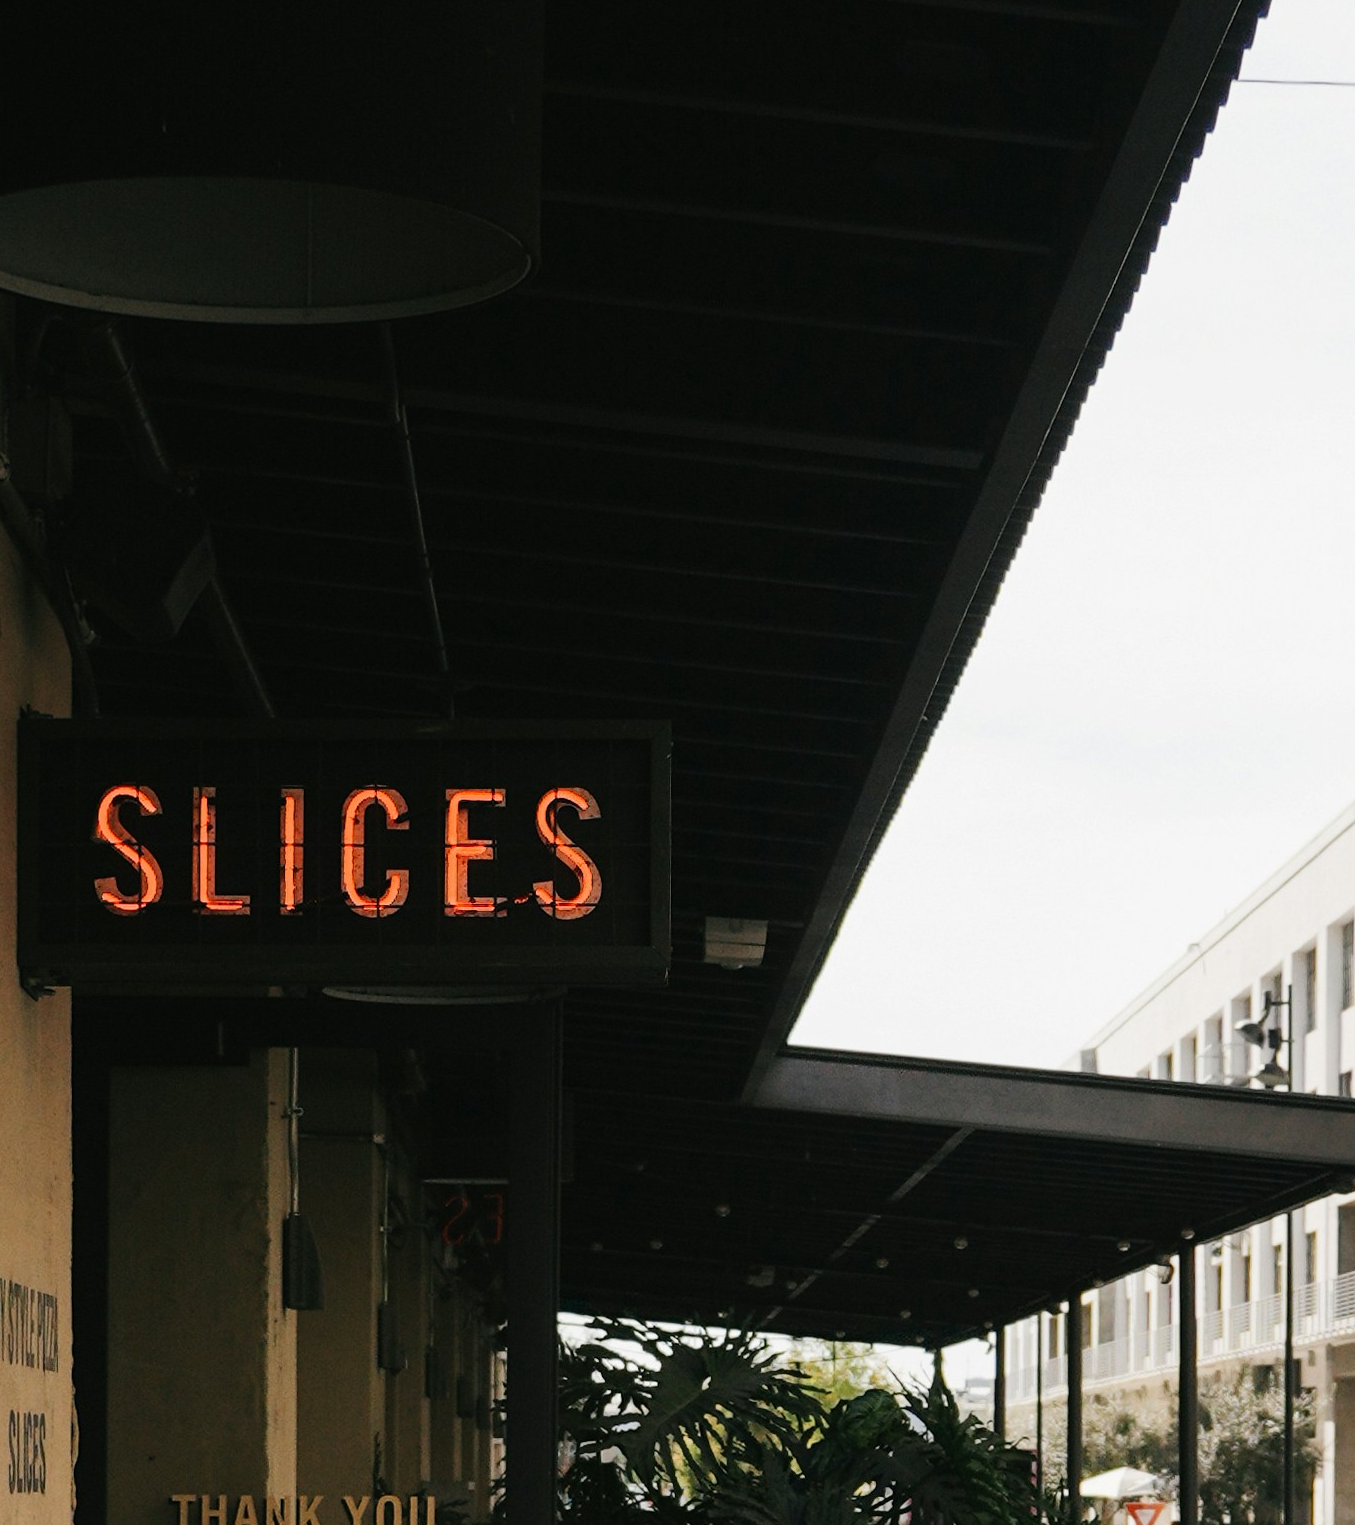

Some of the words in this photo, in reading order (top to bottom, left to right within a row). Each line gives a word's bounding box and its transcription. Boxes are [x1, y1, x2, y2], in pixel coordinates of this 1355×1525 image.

[94, 785, 603, 919] SLICES
[8, 1280, 35, 1368] STYLE
[36, 1291, 59, 1373] PIZZA
[8, 1409, 47, 1495] SLICES
